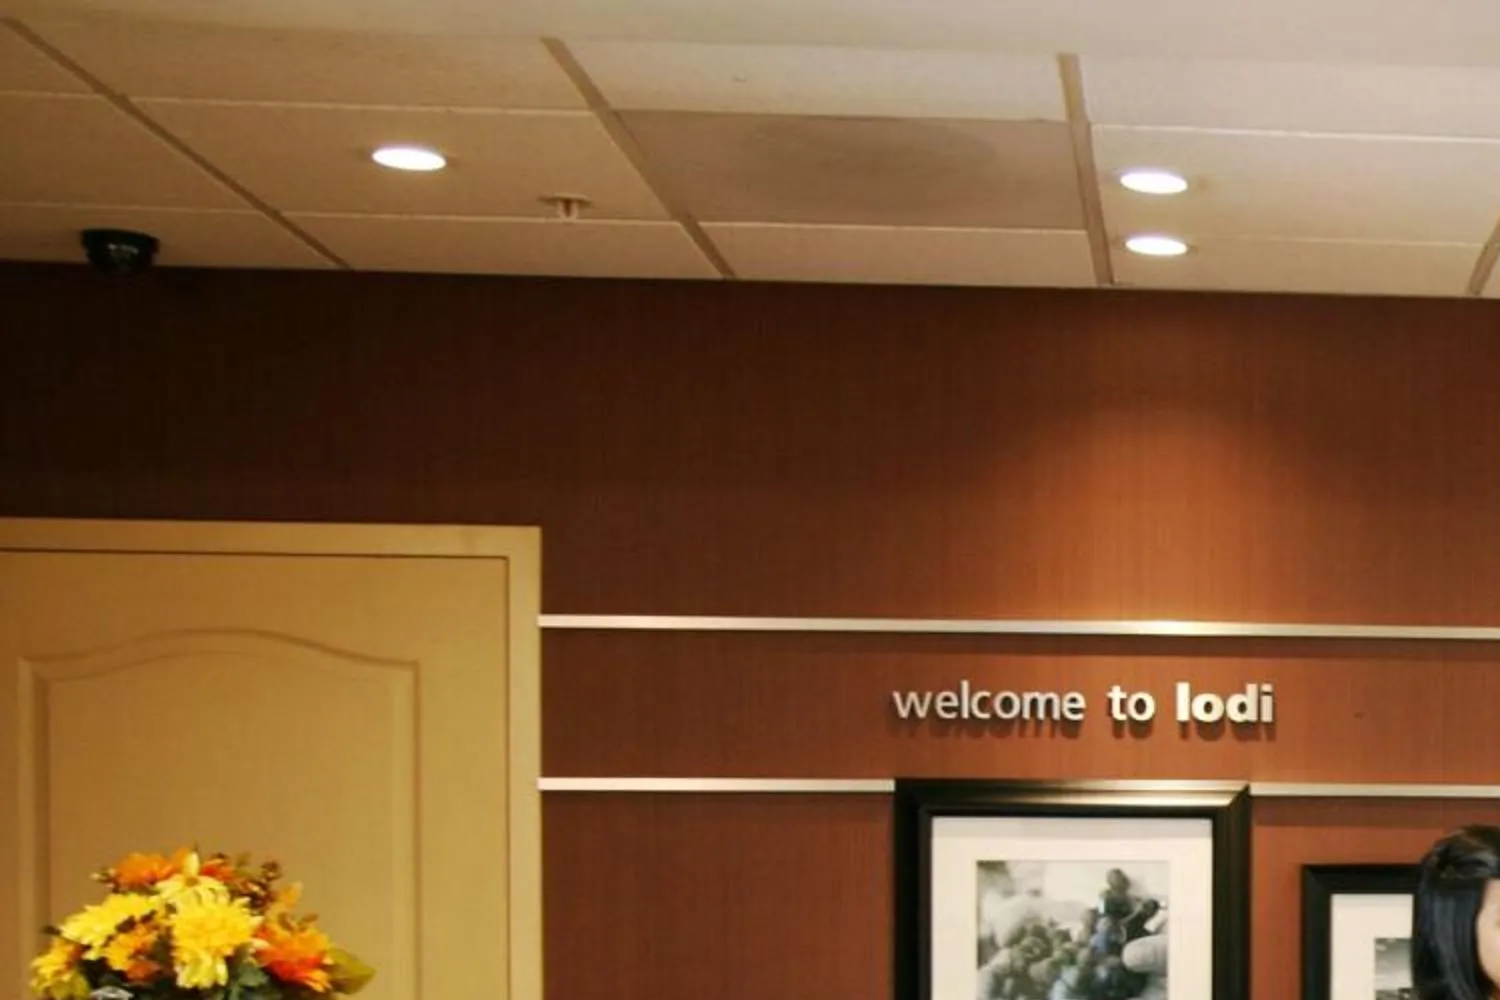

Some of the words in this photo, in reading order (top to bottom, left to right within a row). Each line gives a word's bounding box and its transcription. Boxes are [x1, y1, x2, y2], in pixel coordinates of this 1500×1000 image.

[893, 680, 1086, 721] welcome
[1107, 683, 1156, 722] to
[1176, 682, 1274, 723] lodi
